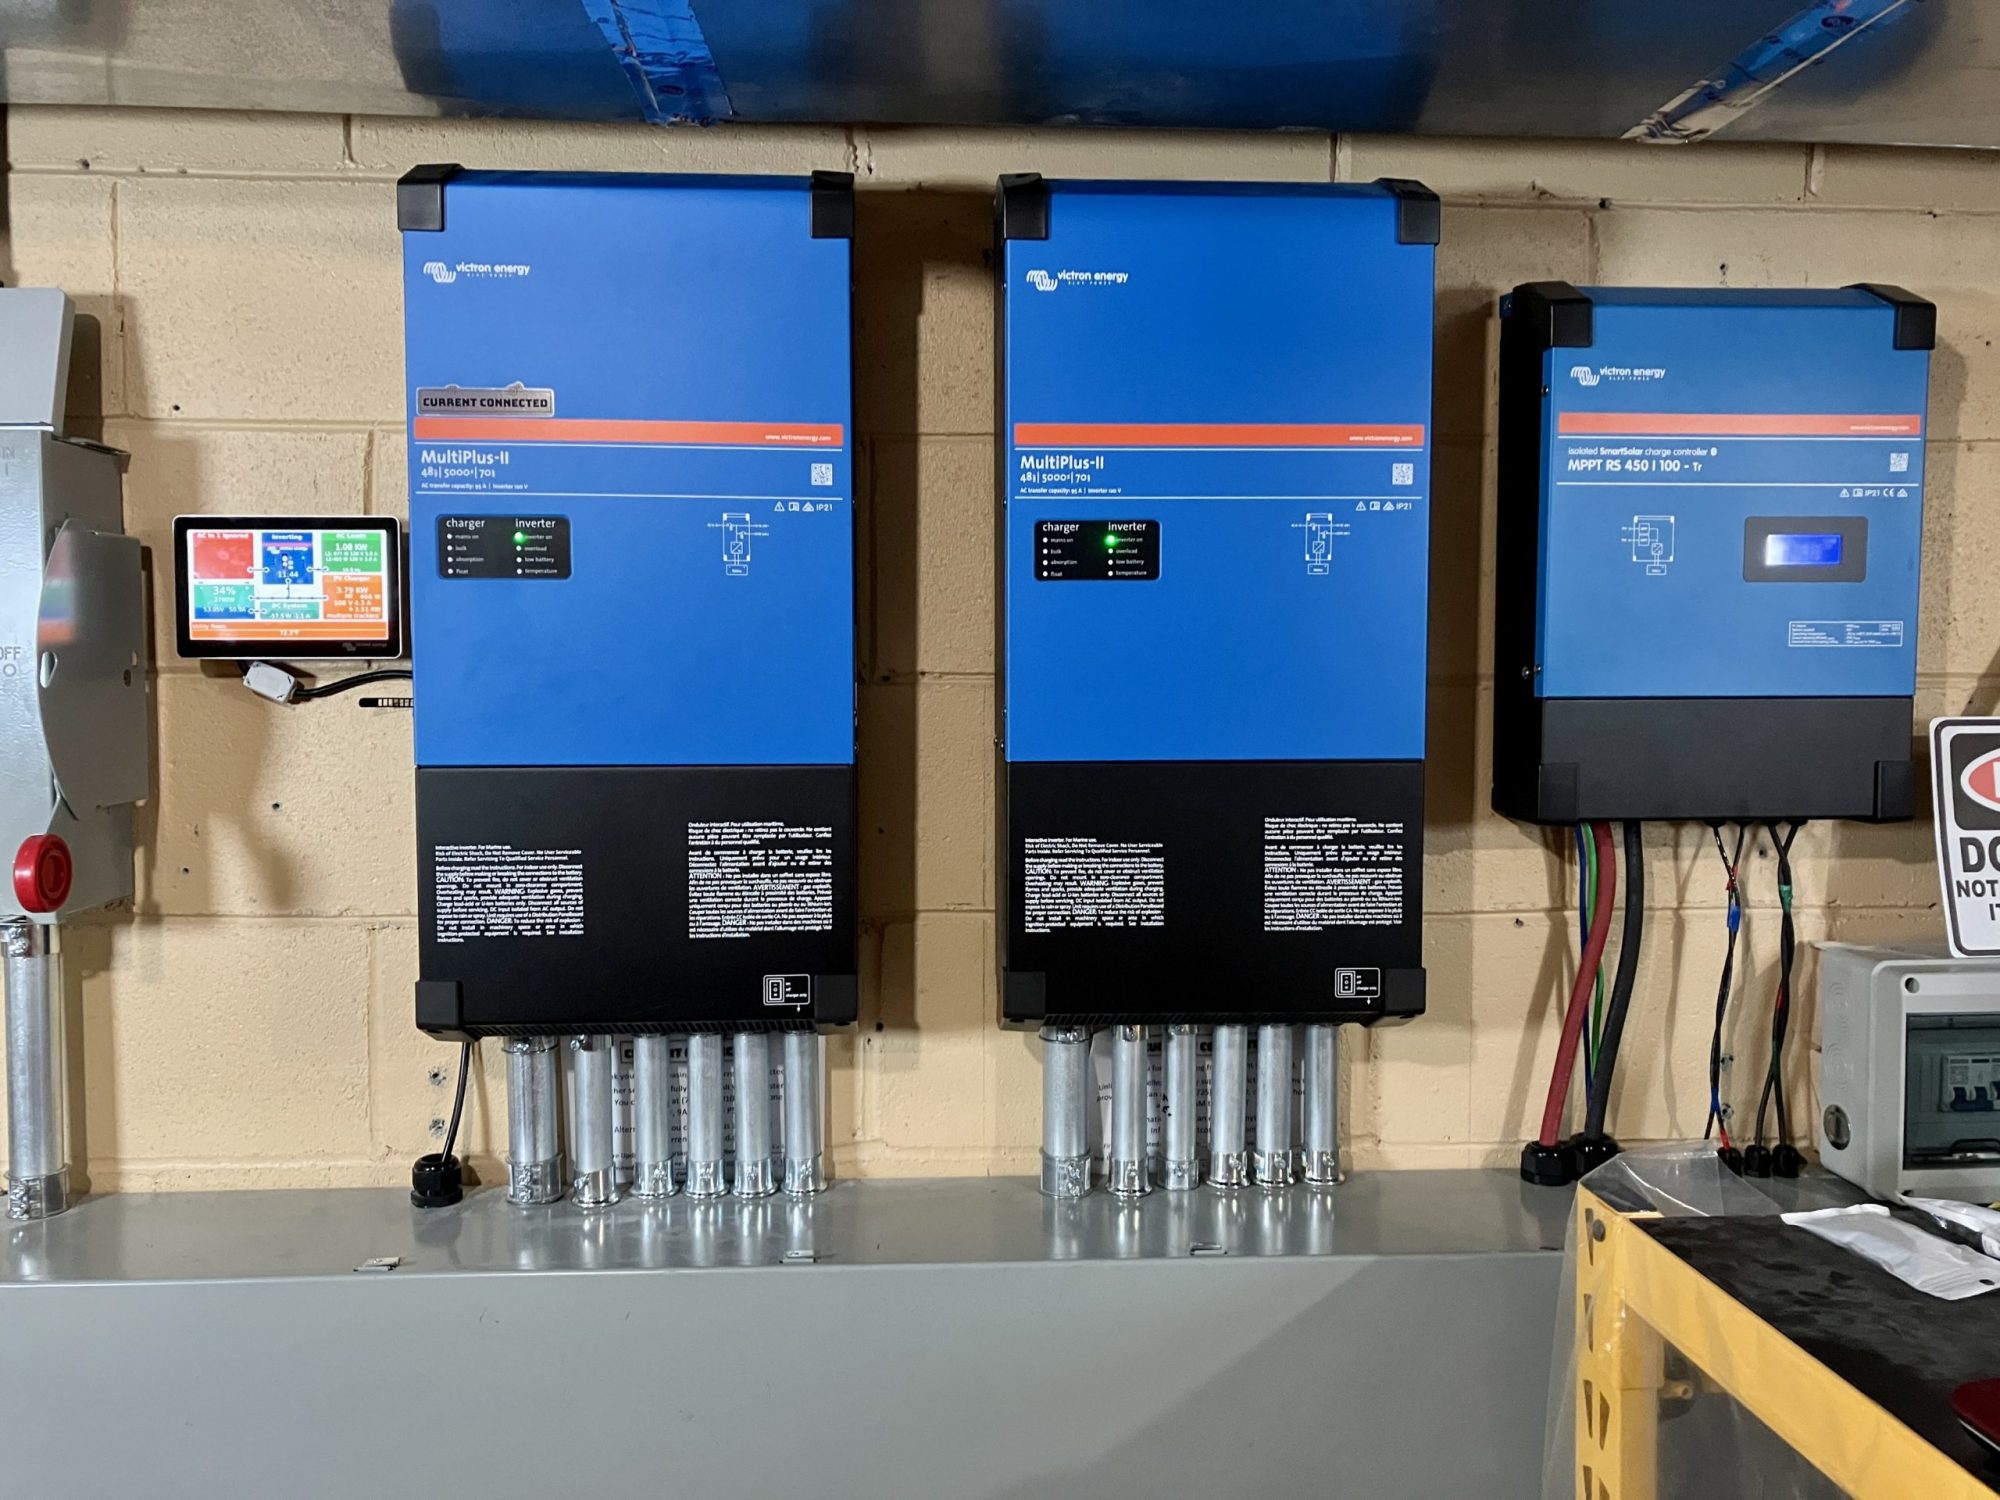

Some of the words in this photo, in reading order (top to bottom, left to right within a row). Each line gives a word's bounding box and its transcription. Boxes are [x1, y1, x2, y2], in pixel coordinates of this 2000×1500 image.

[456, 262, 491, 273] victron
[494, 263, 530, 276] energy
[1058, 270, 1092, 280] victron
[1094, 272, 1128, 284] energy
[1600, 366, 1631, 376] victron
[1633, 368, 1666, 379] energy
[423, 398, 477, 407] CURRENT
[480, 398, 548, 408] CONNECTED
[765, 434, 832, 442] www.victronenergy.com
[420, 449, 509, 464] MultiPlus-II
[1568, 447, 1598, 456] isolated
[1600, 447, 1644, 456] SmartSolar
[1644, 448, 1671, 458] charge
[1673, 448, 1708, 456] controller
[1020, 455, 1104, 470] MultiPlus-II
[1568, 460, 1603, 472] MPPT
[1606, 460, 1621, 472] RS
[1624, 460, 1648, 472] 450
[1660, 460, 1680, 472] 100
[1692, 462, 1702, 472] Tr
[446, 518, 485, 530] charger
[515, 518, 555, 528] inverter
[1042, 522, 1079, 534] charger
[1108, 522, 1146, 531] inverter
[213, 586, 236, 595] 34%
[1956, 880, 1998, 898] NOT
